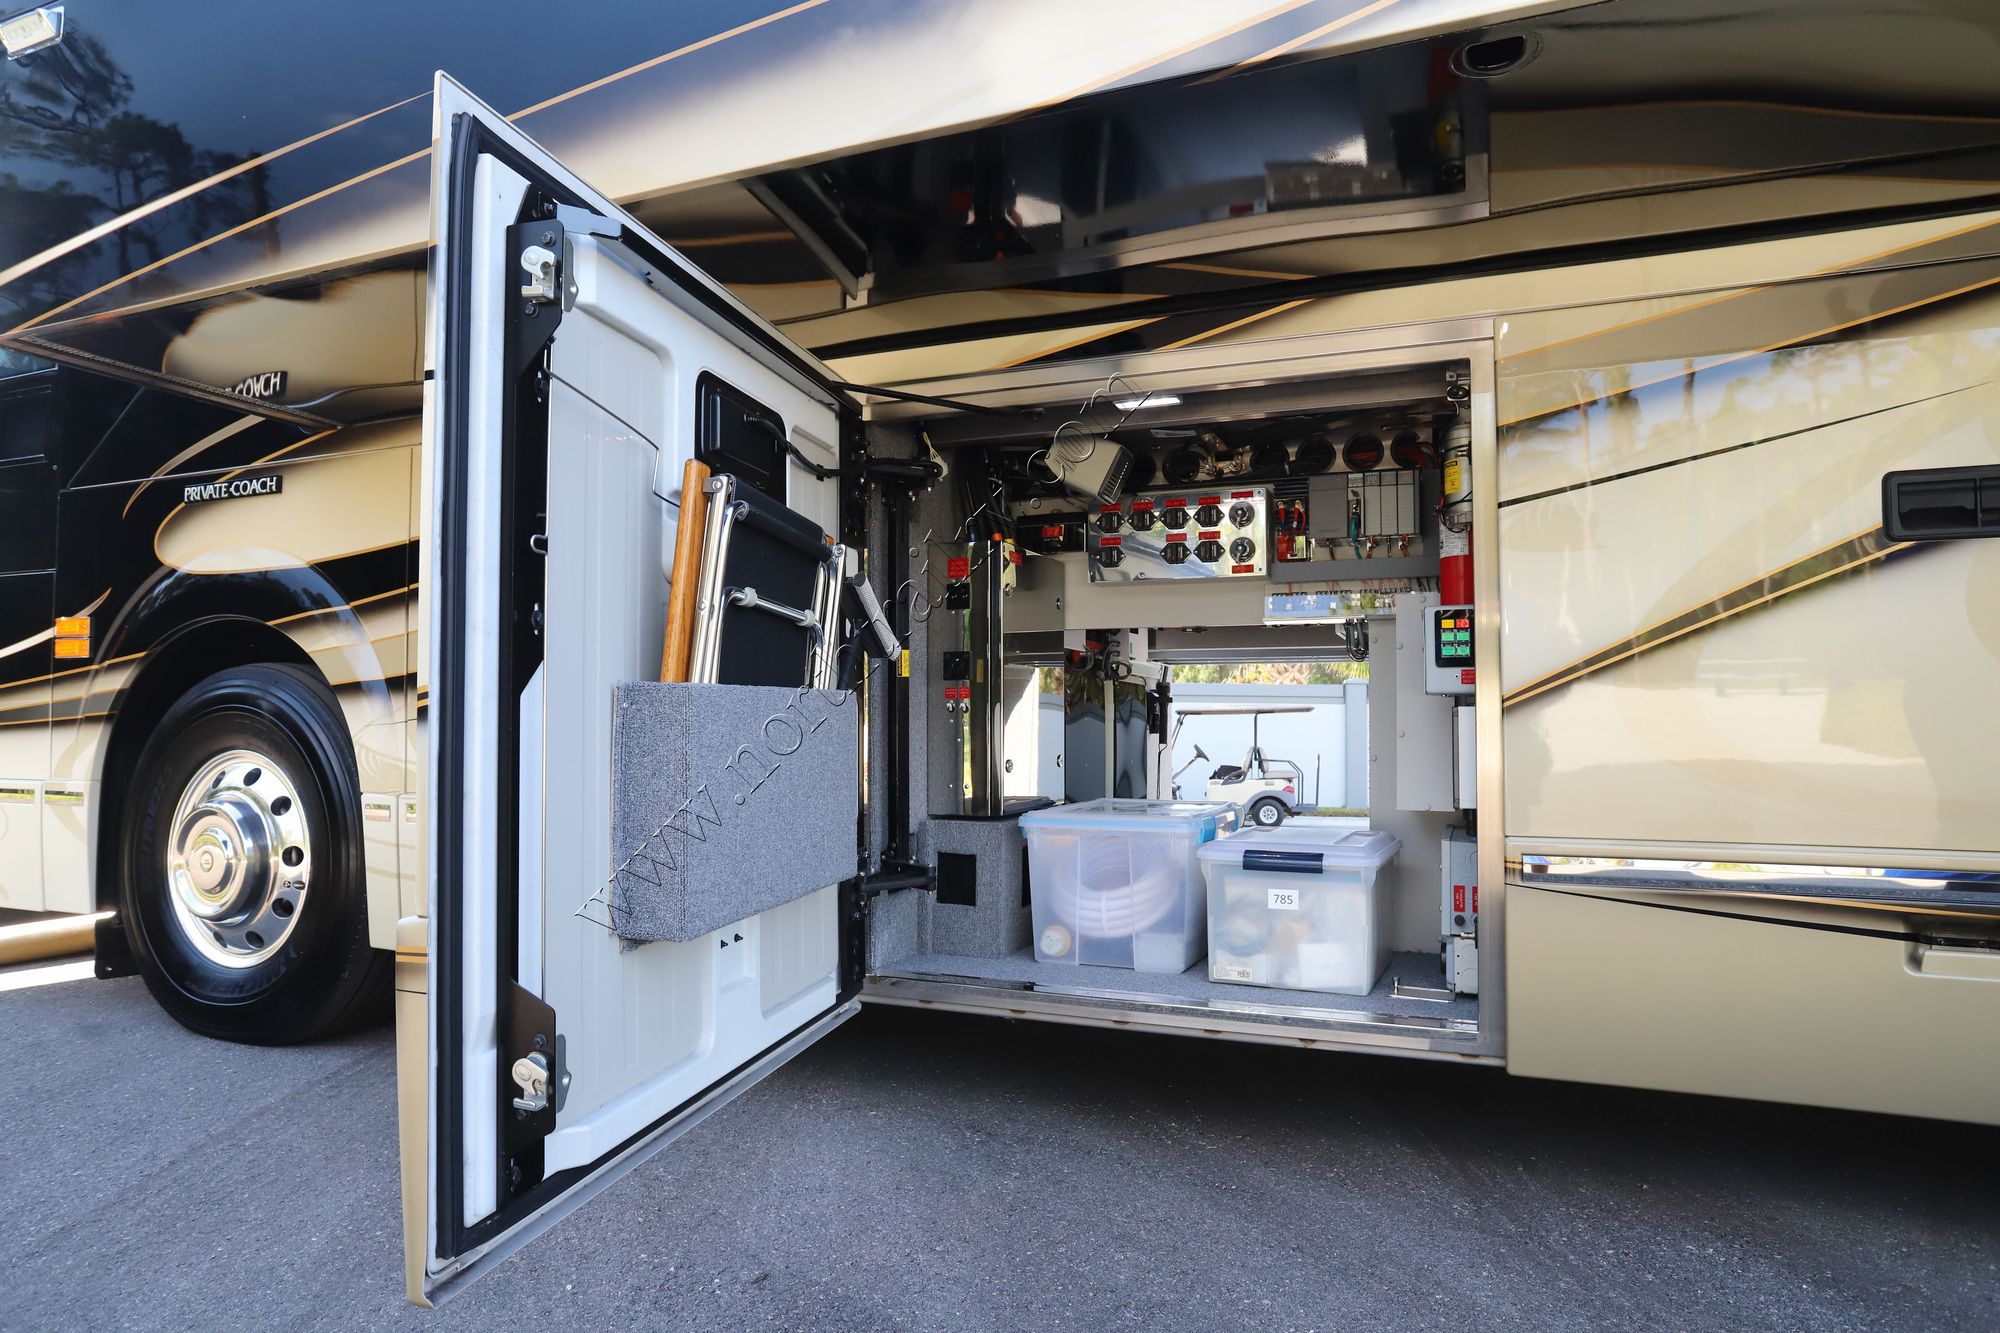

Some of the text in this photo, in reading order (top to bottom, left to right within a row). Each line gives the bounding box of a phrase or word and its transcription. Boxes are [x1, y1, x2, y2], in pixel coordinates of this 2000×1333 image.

[184, 477, 277, 502] PRIVATE COACH
[1273, 894, 1294, 905] 785
